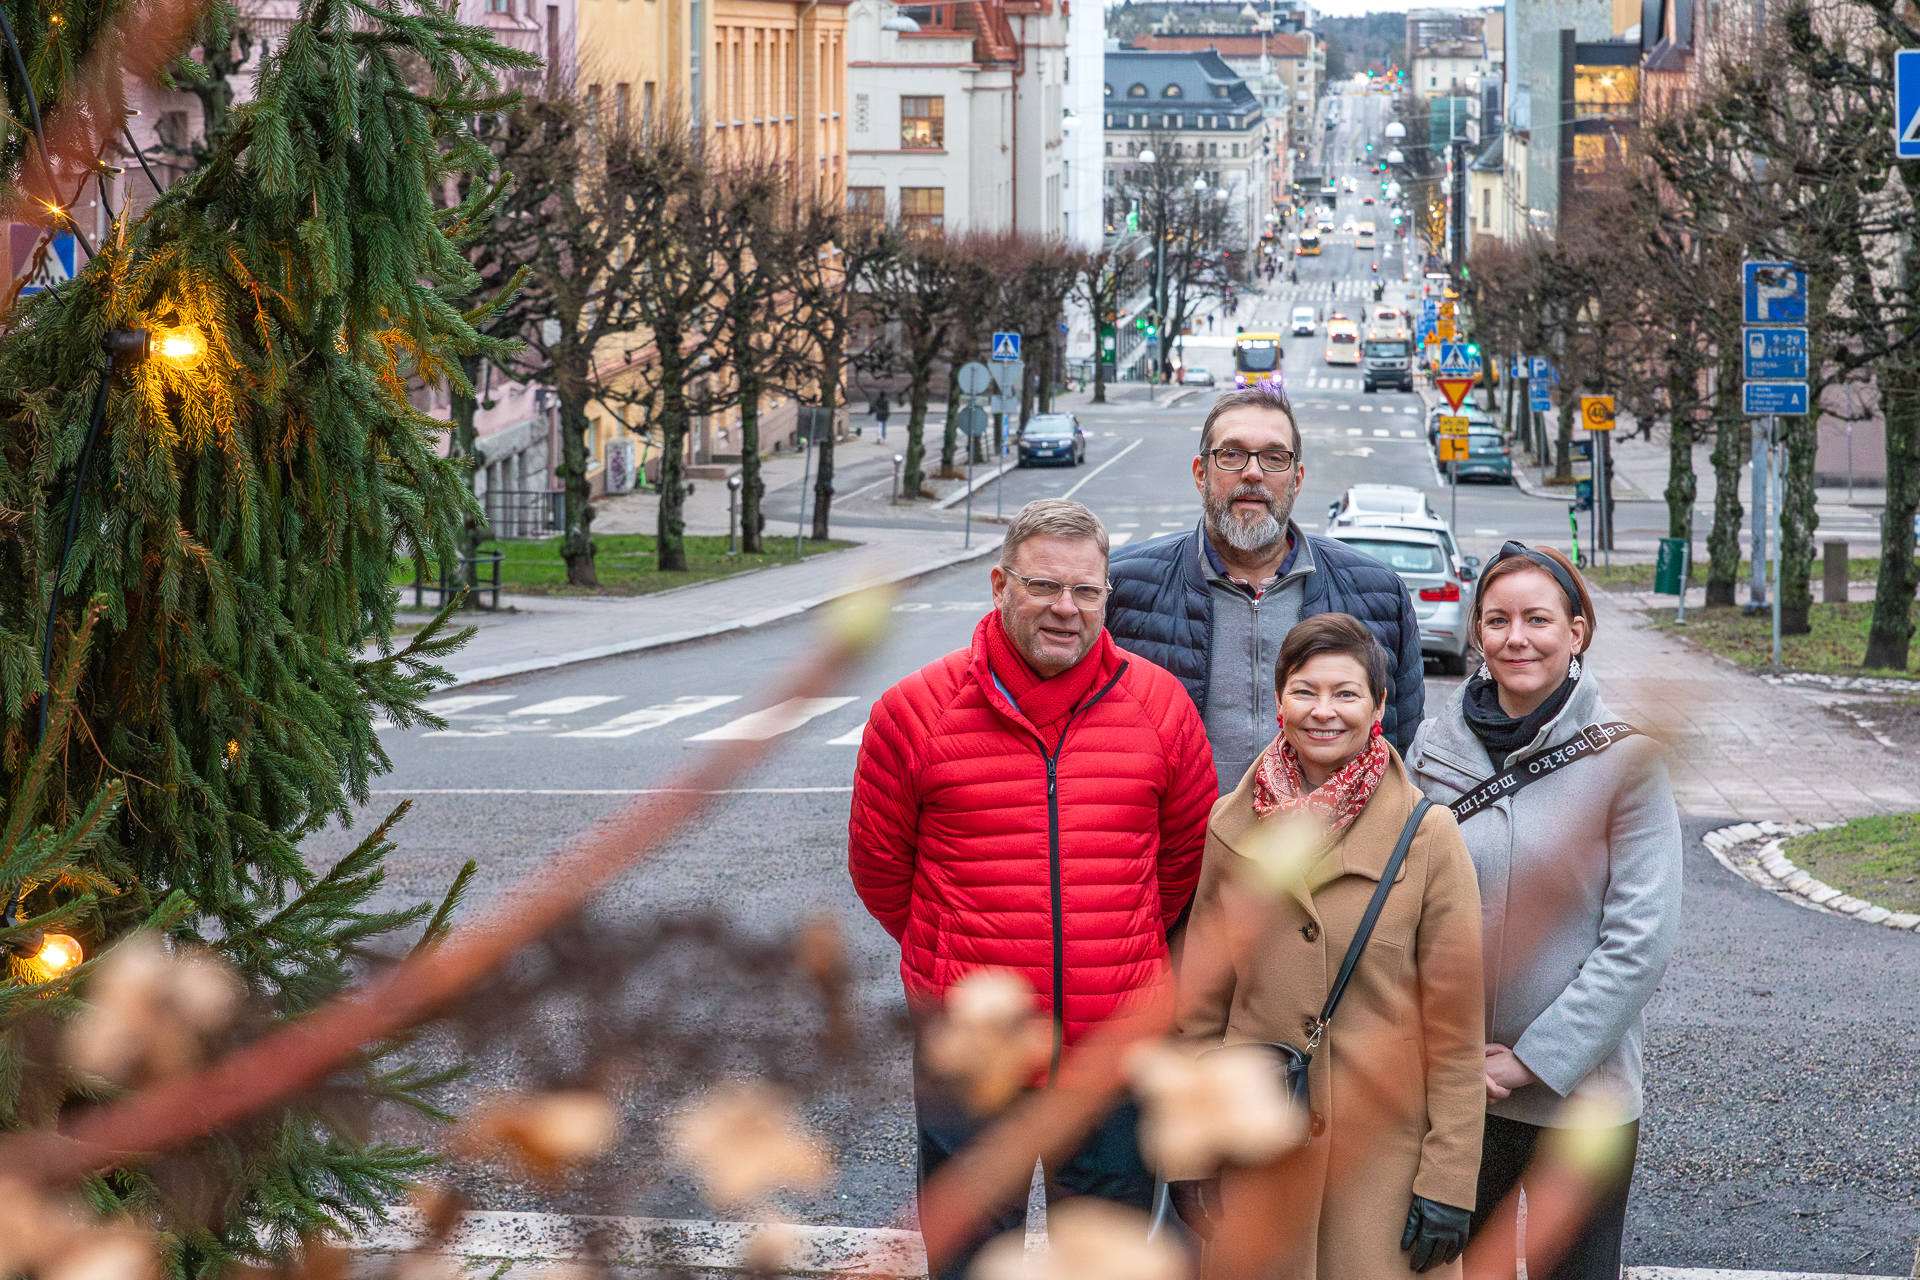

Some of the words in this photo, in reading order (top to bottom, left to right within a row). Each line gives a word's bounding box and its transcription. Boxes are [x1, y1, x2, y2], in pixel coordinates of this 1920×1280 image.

[1757, 266, 1798, 320] P
[1533, 358, 1547, 378] P
[1791, 393, 1800, 405] A
